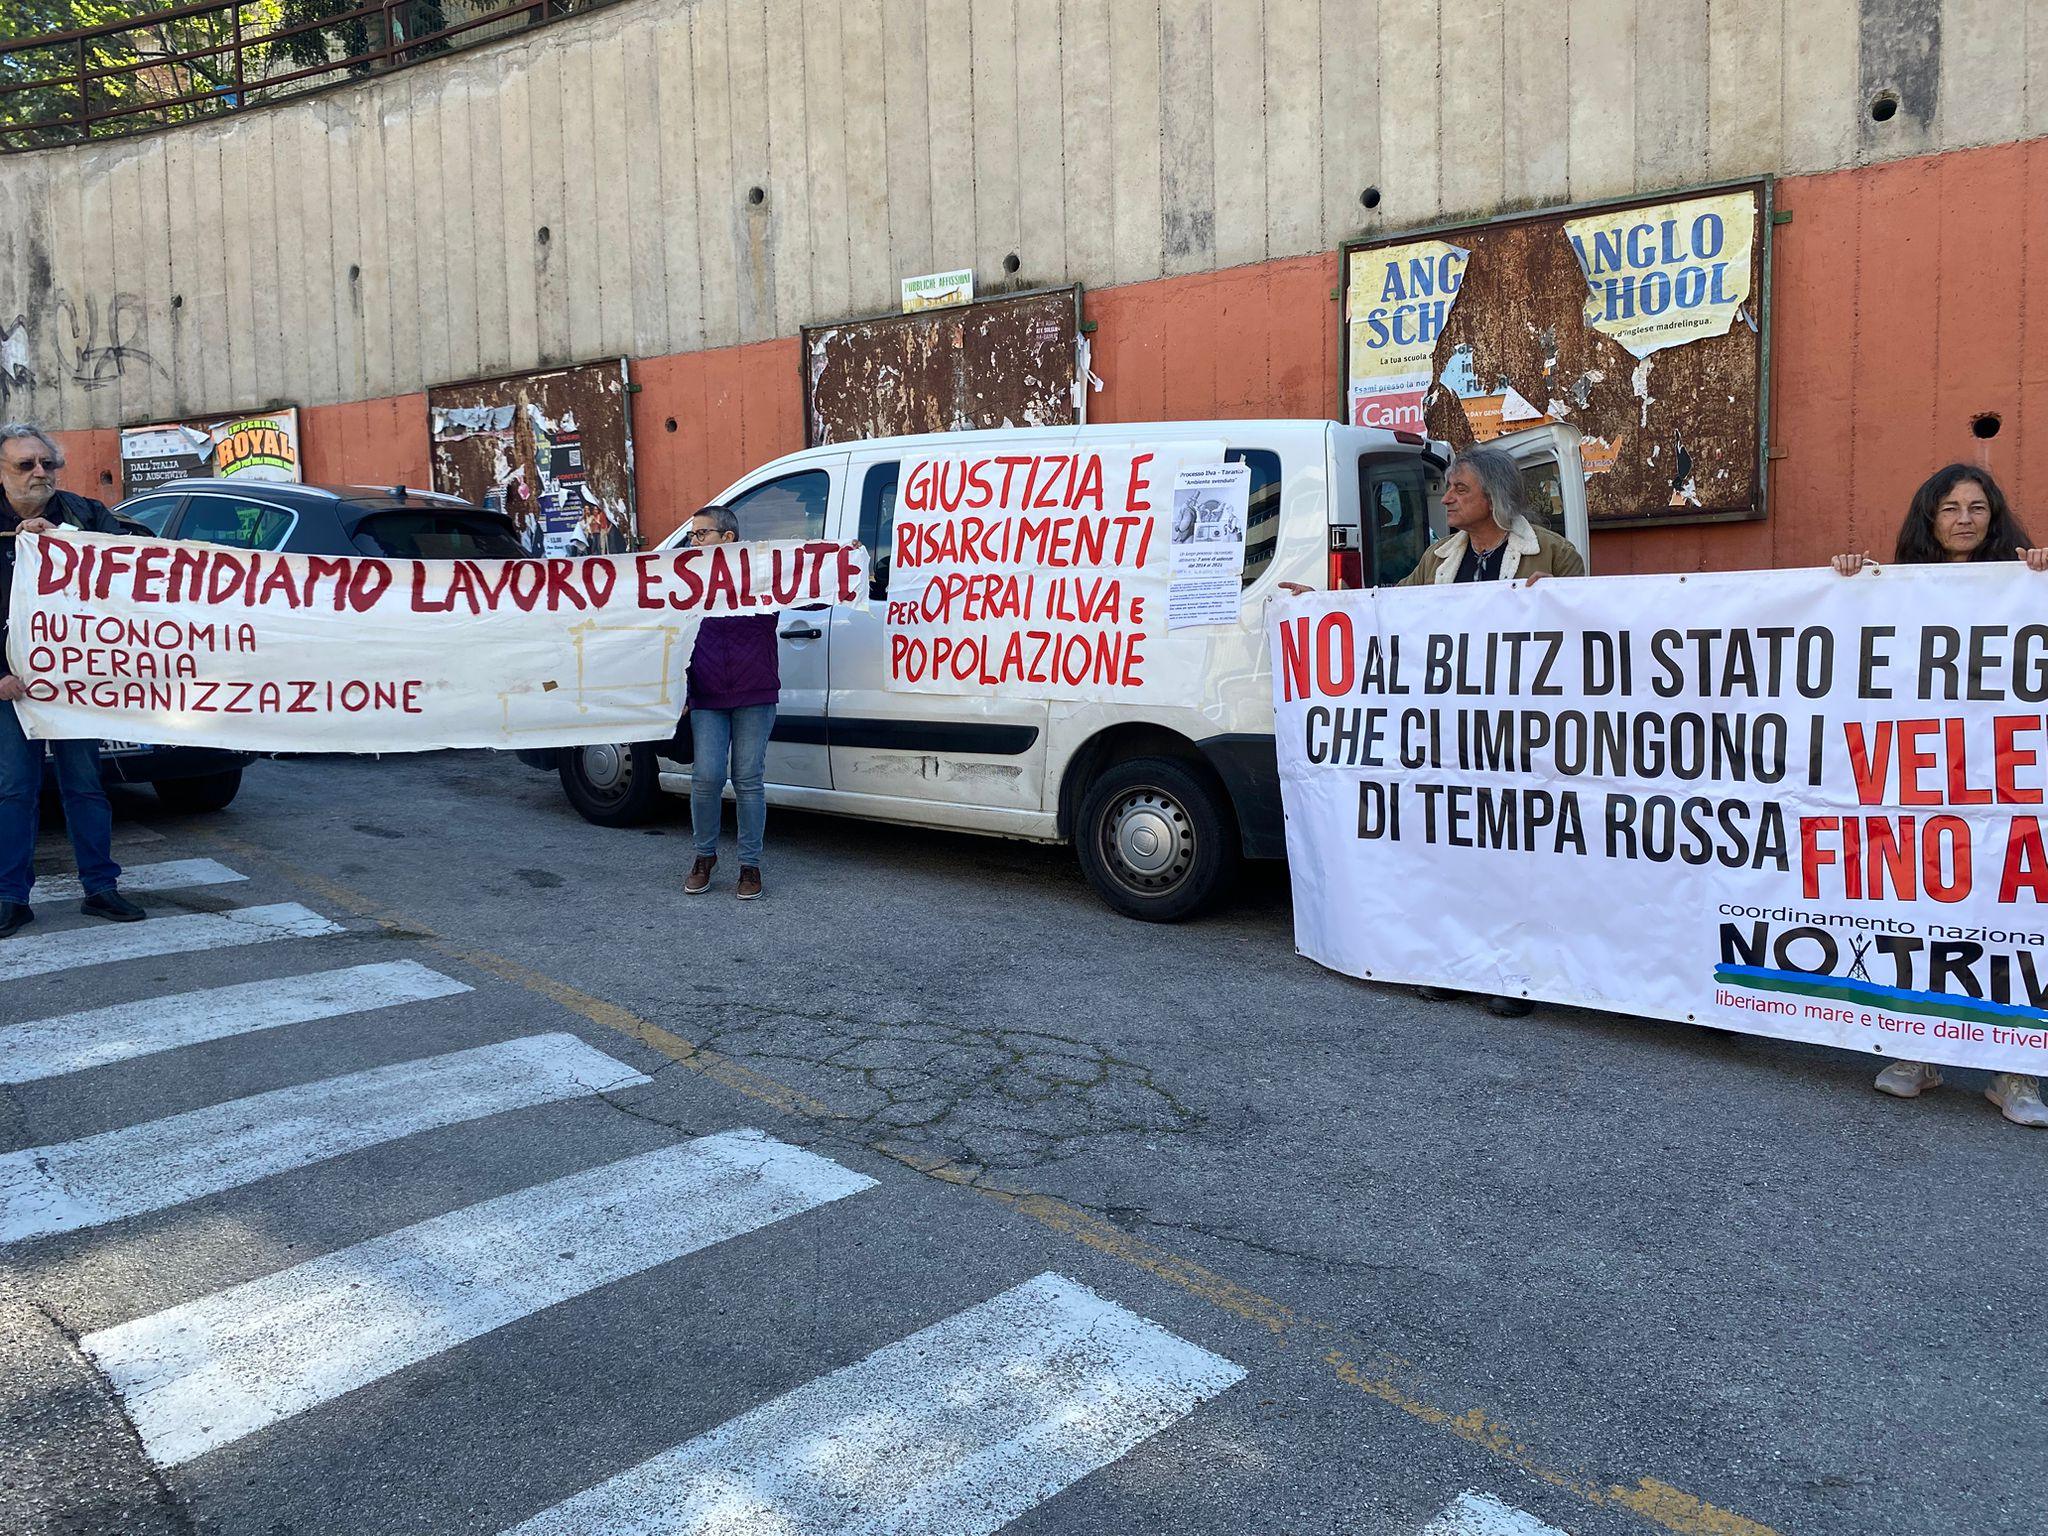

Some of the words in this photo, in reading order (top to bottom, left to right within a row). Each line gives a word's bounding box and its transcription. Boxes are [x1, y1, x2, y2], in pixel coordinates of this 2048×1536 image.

[904, 278, 936, 293] PUBBLICHE
[938, 273, 971, 288] AFFISSIONI
[1367, 299, 1455, 349] SCH
[1617, 325, 1654, 338] d'inglese
[1656, 317, 1713, 331] madrelingua.
[1380, 357, 1389, 365] La
[1390, 355, 1401, 363] tua
[1403, 350, 1427, 362] scuola
[1354, 384, 1377, 393] Esami
[1379, 382, 1405, 393] presso
[216, 428, 296, 471] ROYAL
[228, 420, 280, 436] IMPERIAL
[130, 459, 179, 472] DALL'ITALIA
[131, 473, 143, 481] AD
[145, 470, 188, 481] AUSCHWITZ
[905, 454, 1104, 512] GIUSTIZIA
[1126, 453, 1154, 512] E
[897, 515, 1154, 569] RISARCIMENTI
[37, 535, 393, 613] DIFENDIAMO
[411, 557, 617, 615] LAVORO
[887, 601, 918, 625] PER
[921, 573, 1034, 624] OPERAI
[1046, 577, 1121, 624] ILVA
[1130, 597, 1145, 624] E
[31, 610, 256, 652] AUTONOMIA
[29, 646, 197, 679] OPERAIA
[892, 631, 1147, 687] POPOLAZIONE
[1280, 611, 1355, 702] NO
[1361, 634, 1410, 695] AL
[1424, 631, 1564, 695] BLITZ
[1582, 630, 1632, 696] DI
[1651, 626, 1834, 699] STATO
[1858, 626, 1896, 699] E
[1917, 624, 2048, 702] REG
[25, 678, 423, 714] ORGANIZZAZIONE
[1306, 705, 1388, 766] CHE
[1400, 708, 1442, 769] CI
[1458, 709, 1788, 784] IMPONGONO
[1808, 714, 1825, 786] I
[1843, 715, 2048, 806] VELE
[1357, 780, 1401, 842] DI
[1415, 783, 1587, 856] TEMPA
[1605, 793, 1790, 872] ROSSA
[1799, 815, 1973, 903] FINO
[1997, 815, 2048, 903] A
[1718, 903, 1915, 935] coordinamento
[1928, 922, 2046, 946] naziona
[1719, 920, 1839, 976] NO
[1715, 989, 1797, 1016] liberiamo
[1805, 1004, 1854, 1023] mare
[1860, 1012, 1871, 1027] e
[1877, 1013, 1925, 1035] terre
[1934, 1020, 1985, 1042] dalle
[1992, 1026, 2048, 1050] trivel
